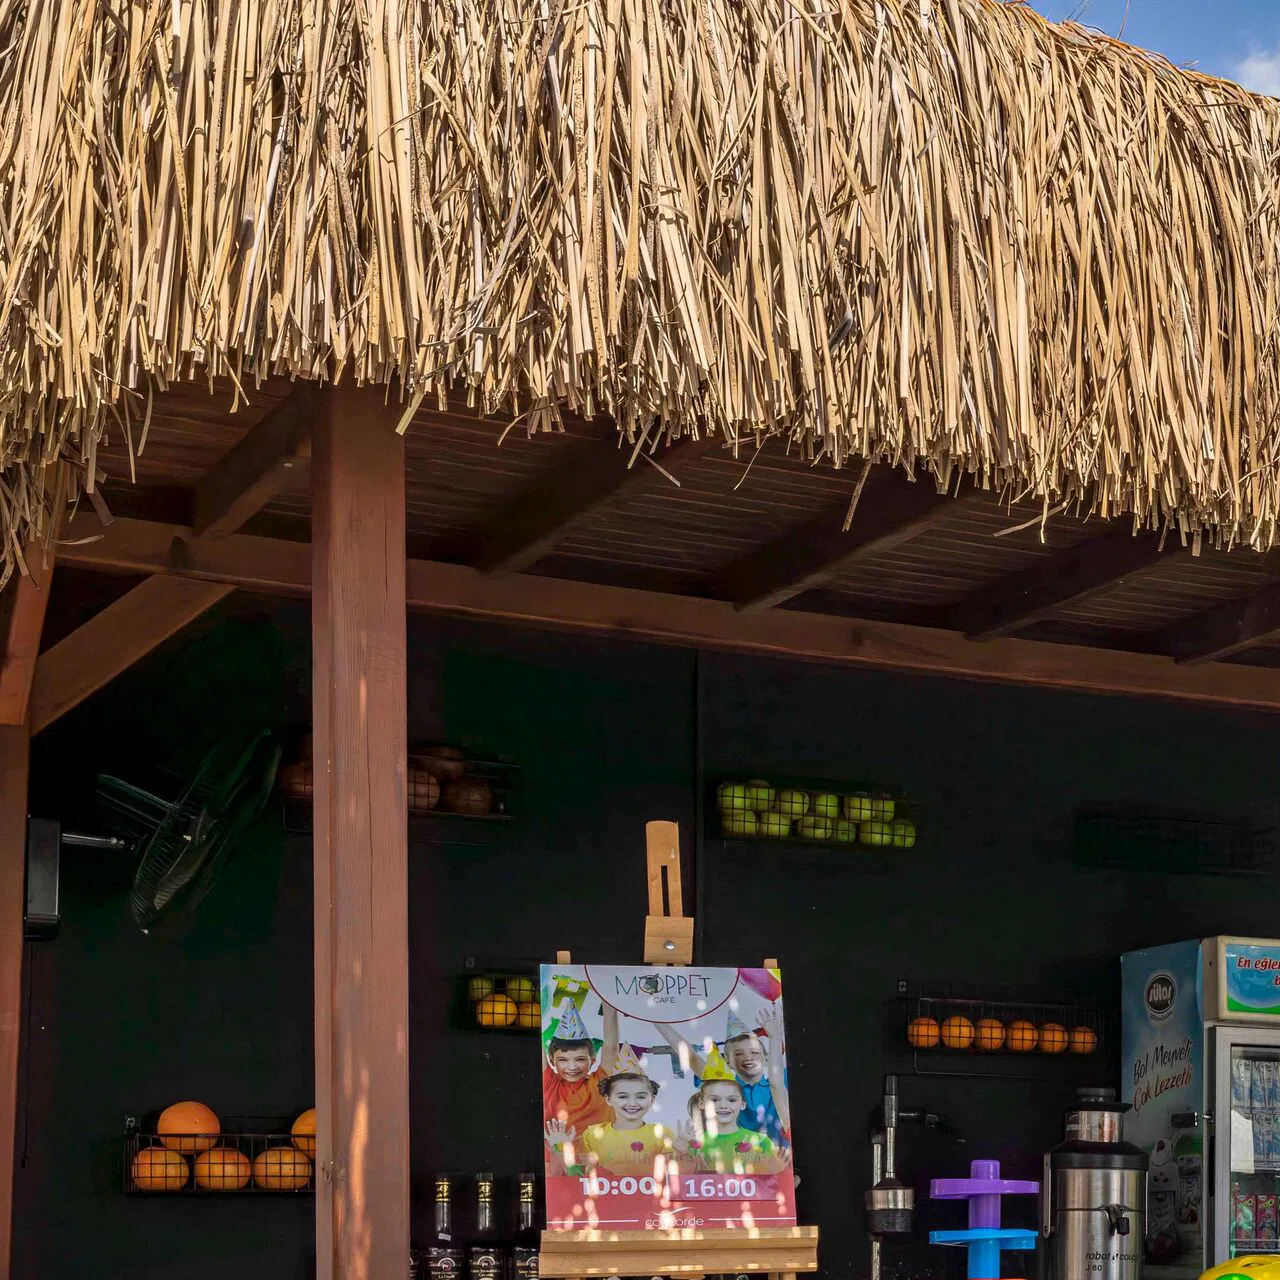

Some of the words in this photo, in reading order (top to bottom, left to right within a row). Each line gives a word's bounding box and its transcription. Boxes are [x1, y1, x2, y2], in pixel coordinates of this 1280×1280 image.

[1237, 956, 1250, 968] En
[615, 973, 711, 997] MOPPET
[1134, 1054, 1148, 1085] Bol
[1133, 1082, 1152, 1117] Çok
[1154, 1067, 1192, 1097] Lezzetli
[579, 1176, 657, 1196] 10:00
[684, 1178, 756, 1197] 16:00
[644, 1215, 705, 1229] coorde
[1085, 1251, 1110, 1260] robot
